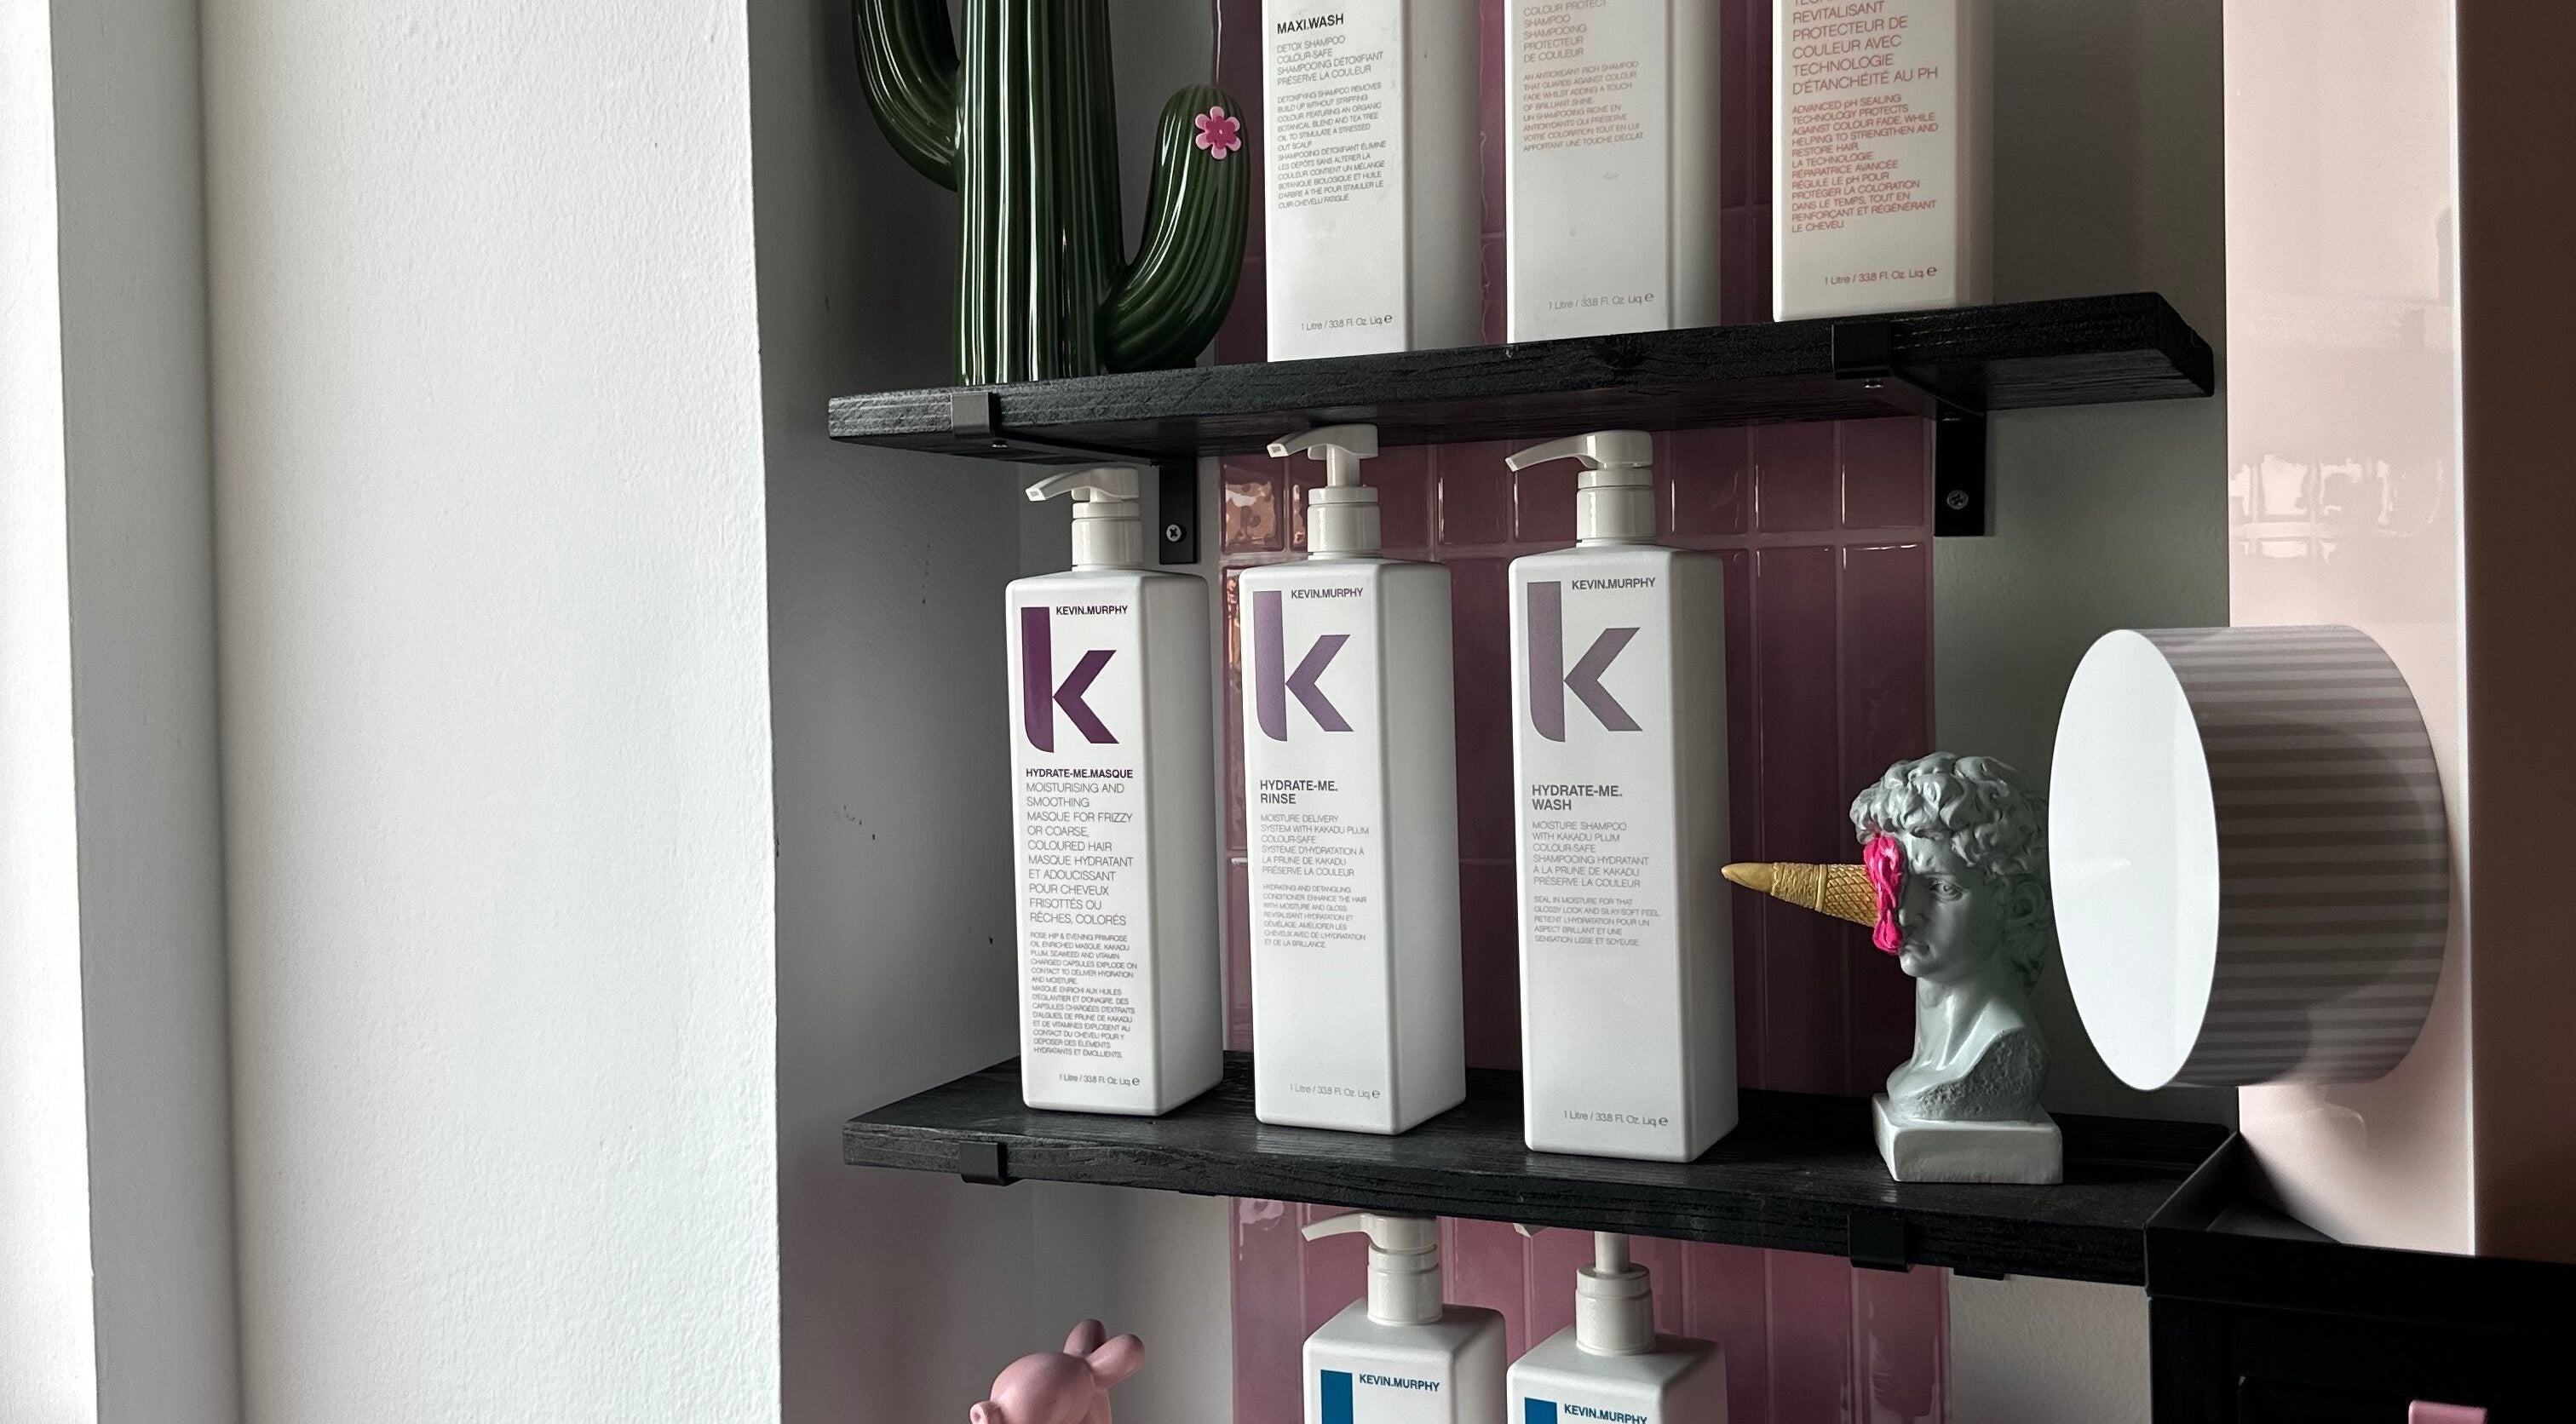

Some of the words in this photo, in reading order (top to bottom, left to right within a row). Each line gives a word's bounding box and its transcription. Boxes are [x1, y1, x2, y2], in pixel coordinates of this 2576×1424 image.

[1792, 1, 1885, 24] REVITALISANT
[1277, 14, 1344, 34] MAXI.WASH
[1523, 14, 1571, 28] SHAMPOO
[1523, 24, 1587, 40] SHAMPOOING
[1792, 18, 1887, 42] PROTECTEUR
[1886, 15, 1908, 30] DE
[1277, 41, 1302, 54] DETOX
[1303, 35, 1345, 50] SHAMPOO
[1524, 36, 1584, 51] PROTECTEUR
[1792, 40, 1860, 60] COULEUR
[1864, 35, 1901, 51] AVEC
[1523, 54, 1535, 63] DE
[1538, 48, 1584, 61] COULEUR
[1792, 55, 1894, 77] TECHNOLOGIE
[1319, 71, 1329, 80] LA
[1792, 110, 1856, 125] TECHNOLOGY
[1858, 105, 1908, 118] PROTECTS
[1836, 133, 1848, 142] TO
[1915, 123, 1938, 135] AND
[1792, 159, 1803, 169] LA
[1807, 152, 1873, 167] TECHNOLOGIE
[1831, 176, 1843, 186] LE
[1843, 187, 1855, 196] LA
[1819, 199, 1830, 209] LE
[1895, 192, 1910, 202] EN
[1856, 206, 1867, 215] ET
[1792, 223, 1803, 233] LE
[1831, 275, 1850, 285] Litre
[1572, 577, 1656, 590] KEVIN.MURPHY
[1291, 588, 1363, 599] KEVIN.MURPHY
[1056, 606, 1128, 615] KEVIN.MURPHY
[1026, 768, 1134, 778] HYDRATE-ME.MASQUE
[1026, 783, 1099, 793] MOISTURISING
[1101, 784, 1124, 793] AND
[1260, 779, 1338, 791] HYDRATE-ME.
[1532, 784, 1622, 797] HYDRATE-ME.
[1026, 796, 1090, 807] SMOOTHING
[1261, 793, 1297, 804] RINSE
[1532, 799, 1572, 811] WASH
[1027, 811, 1070, 822] MASQUE
[1072, 812, 1095, 822] FOR
[1097, 812, 1132, 823] FRIZZY
[1261, 814, 1300, 823] MOISTURE
[1302, 814, 1338, 823] DELIVERY
[1027, 825, 1043, 835] OR
[1044, 826, 1090, 838] COARSE,
[1261, 824, 1291, 833] SYSTEM
[1314, 825, 1345, 834] KAKADU
[1346, 826, 1369, 835] PLUM
[1532, 821, 1577, 830] MOISTURE
[1579, 822, 1627, 831] SHAMPOO
[1532, 832, 1554, 841] WITH
[1556, 832, 1592, 841] KAKADU
[1594, 833, 1620, 842] PLUM
[1027, 840, 1085, 851] COLOURED
[1088, 841, 1113, 852] HAIR
[1028, 855, 1071, 865] MASQUE
[1074, 856, 1134, 866] HYDRATANT
[1273, 856, 1300, 864] PRUNE
[1314, 857, 1346, 865] KAKADU
[1533, 854, 1595, 864] SHAMPOOING
[1596, 856, 1649, 865] HYDRATANT
[1029, 869, 1039, 879] ET
[1043, 870, 1116, 881] ADOUCISSANT
[1262, 865, 1302, 875] PRÉSERVE
[1303, 867, 1314, 876] LA
[1315, 868, 1354, 876] COULEUR
[1541, 865, 1552, 874] LA
[1555, 866, 1585, 875] PRUNE
[1588, 867, 1601, 876] DE
[1602, 867, 1640, 876] KAKADU
[1534, 876, 1578, 887] PRÉSERVE
[1581, 878, 1593, 887] LA
[1594, 879, 1641, 887] COULEUR
[1029, 883, 1057, 893] POUR
[1060, 884, 1109, 895] CHEVEUX
[1029, 897, 1083, 909] FRISOTTÉS
[1085, 899, 1101, 910] OU
[1030, 911, 1072, 924] RÊCHES,
[1075, 913, 1126, 925] COLORÉS
[1570, 1111, 1588, 1121] Litre
[1359, 1374, 1440, 1392] KEVIN.MURPHY
